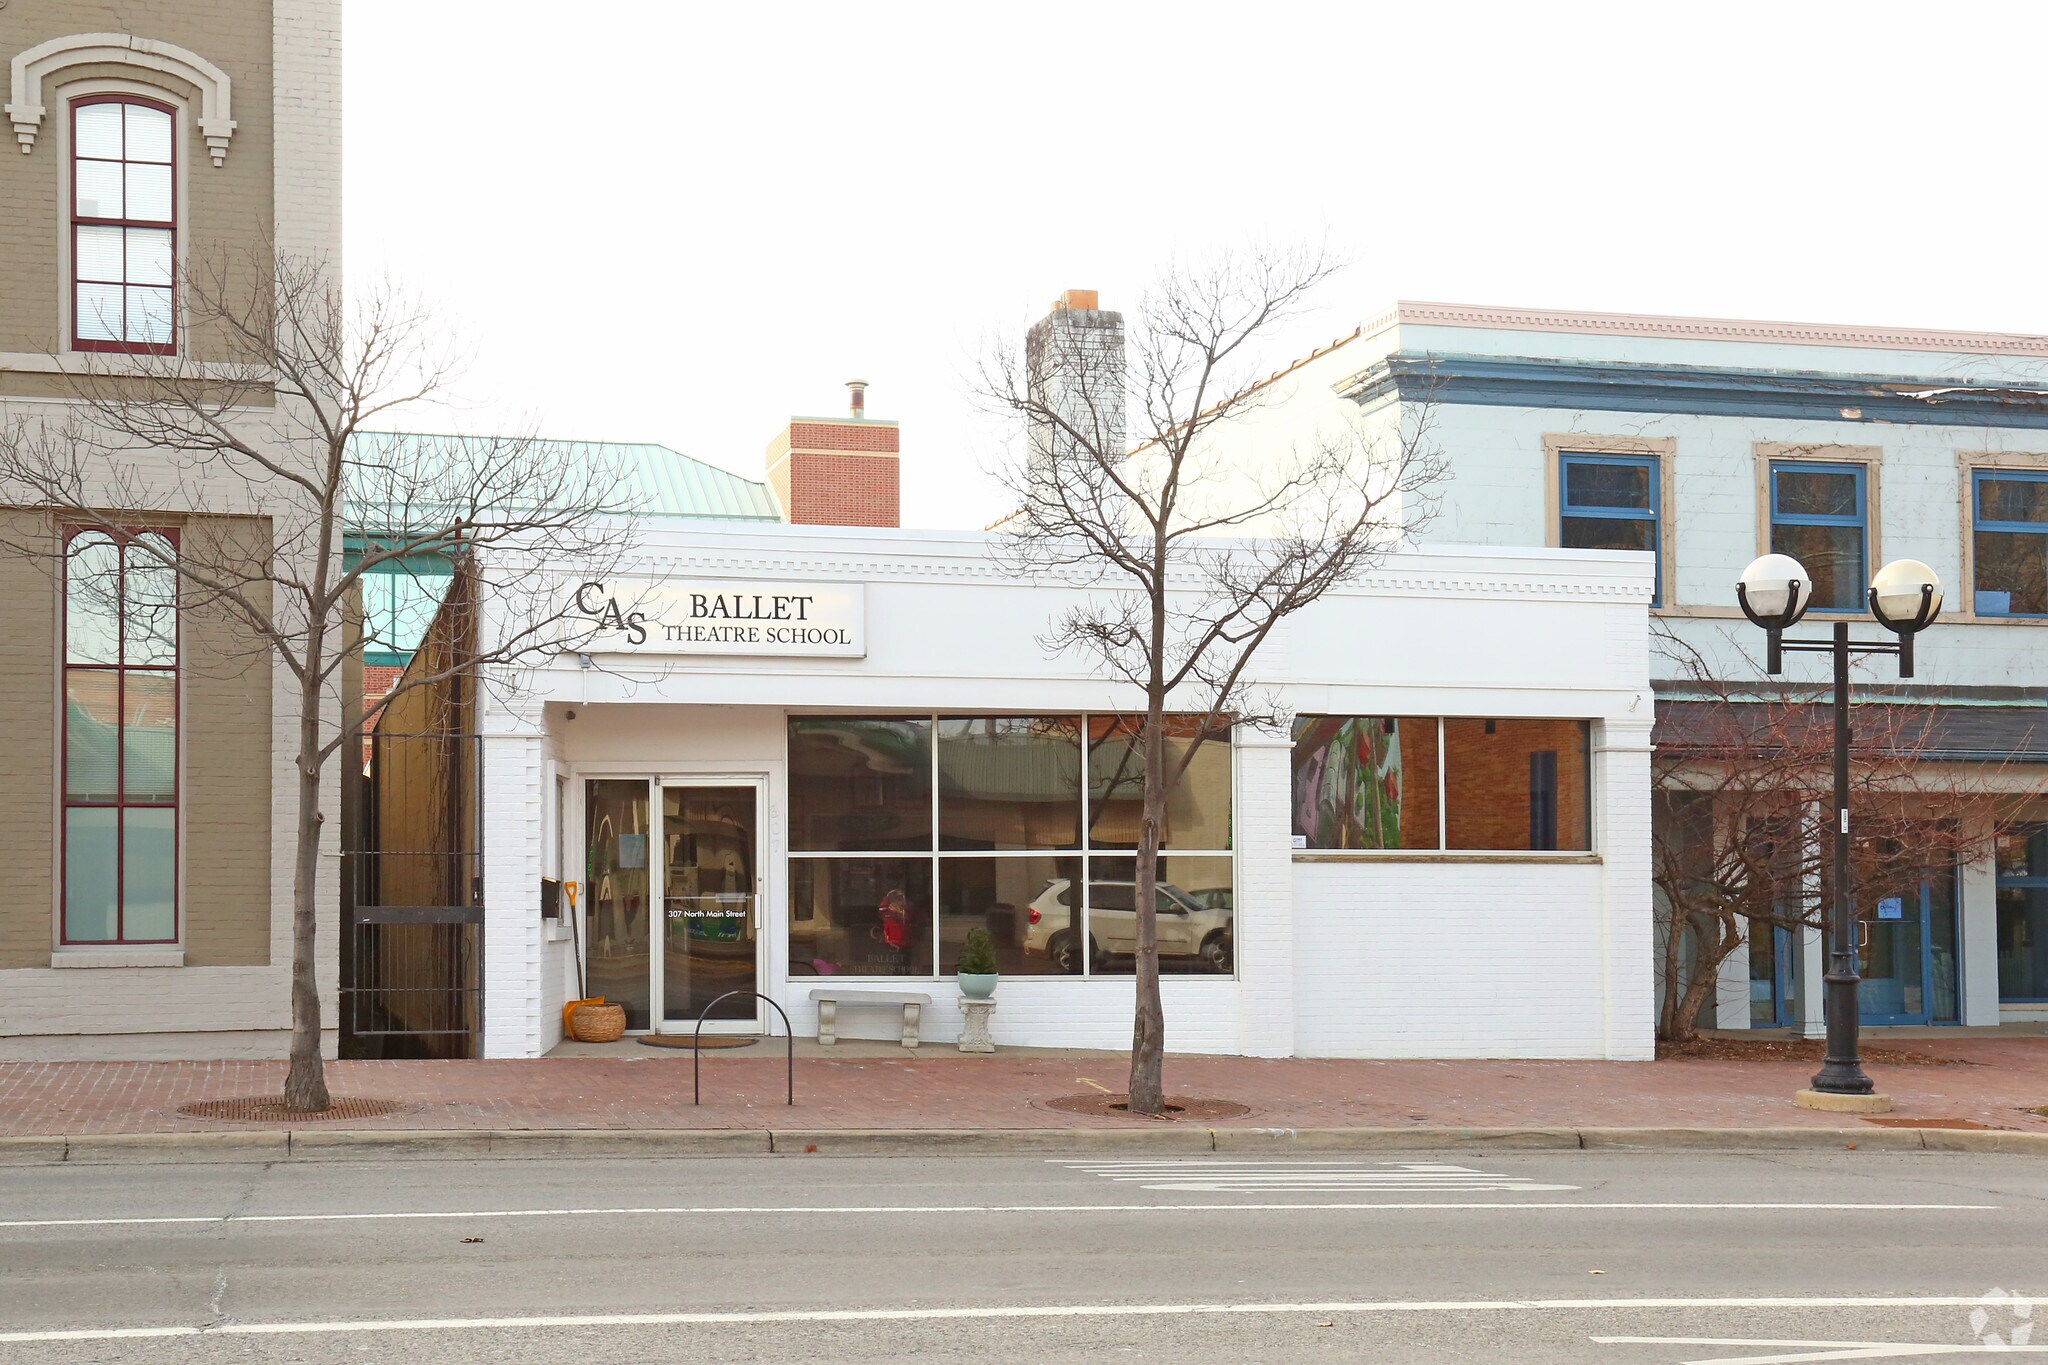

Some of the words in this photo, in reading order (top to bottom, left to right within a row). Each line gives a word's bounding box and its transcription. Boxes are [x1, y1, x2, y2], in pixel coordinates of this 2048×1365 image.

[576, 582, 647, 645] CAS
[690, 593, 813, 621] BALLET
[661, 625, 760, 643] THEATRE
[766, 627, 851, 645] SCHOOL
[668, 910, 682, 918] 307
[684, 910, 705, 918] North
[706, 910, 724, 918] Main
[725, 910, 746, 918] Street
